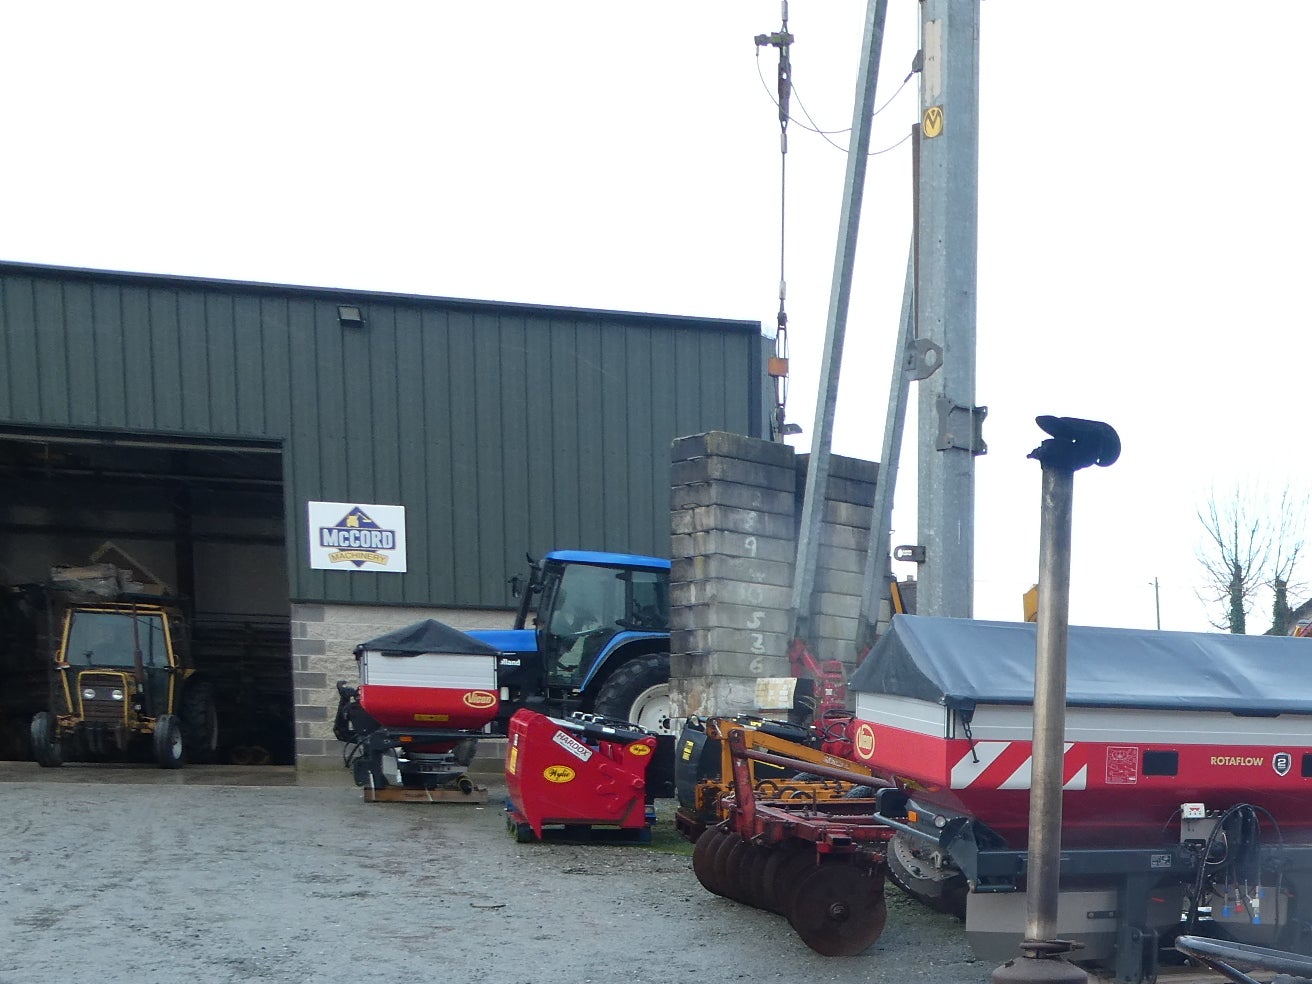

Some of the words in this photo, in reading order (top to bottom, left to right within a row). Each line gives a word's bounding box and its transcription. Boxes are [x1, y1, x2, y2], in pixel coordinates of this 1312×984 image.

[330, 550, 387, 563] MACHINERY
[556, 732, 591, 757] HARDOX
[1210, 756, 1264, 766] ROTAFLOW
[1277, 758, 1287, 767] 2
